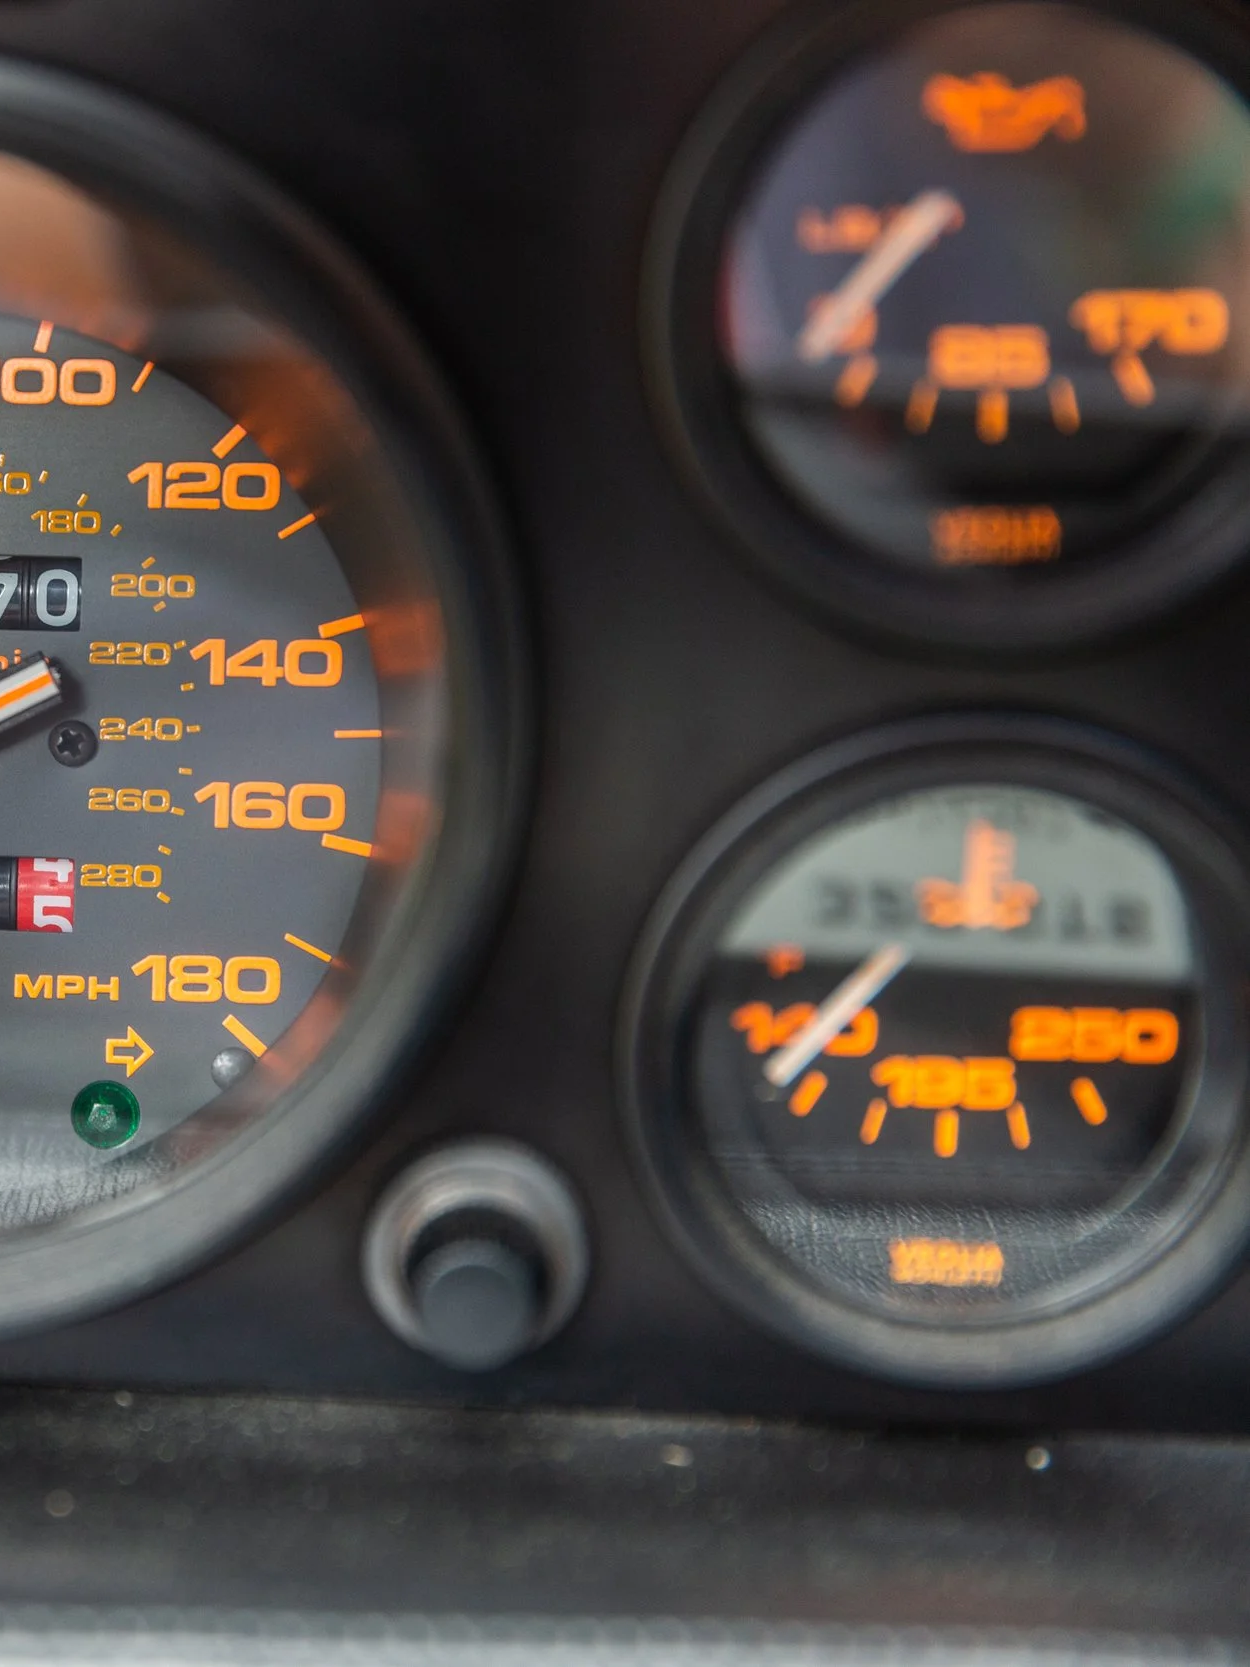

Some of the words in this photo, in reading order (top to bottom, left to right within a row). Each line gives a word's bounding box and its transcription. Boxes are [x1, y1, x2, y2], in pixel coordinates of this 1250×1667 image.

[126, 460, 281, 512] 120
[30, 509, 102, 535] 180
[110, 573, 196, 599] 200
[88, 640, 171, 666] 220
[189, 637, 344, 688] 140
[99, 716, 184, 742] 240
[88, 786, 171, 813] 260
[193, 780, 347, 832] 160
[79, 862, 163, 888] 280
[13, 972, 121, 1002] MPH
[131, 953, 282, 1006] 180
